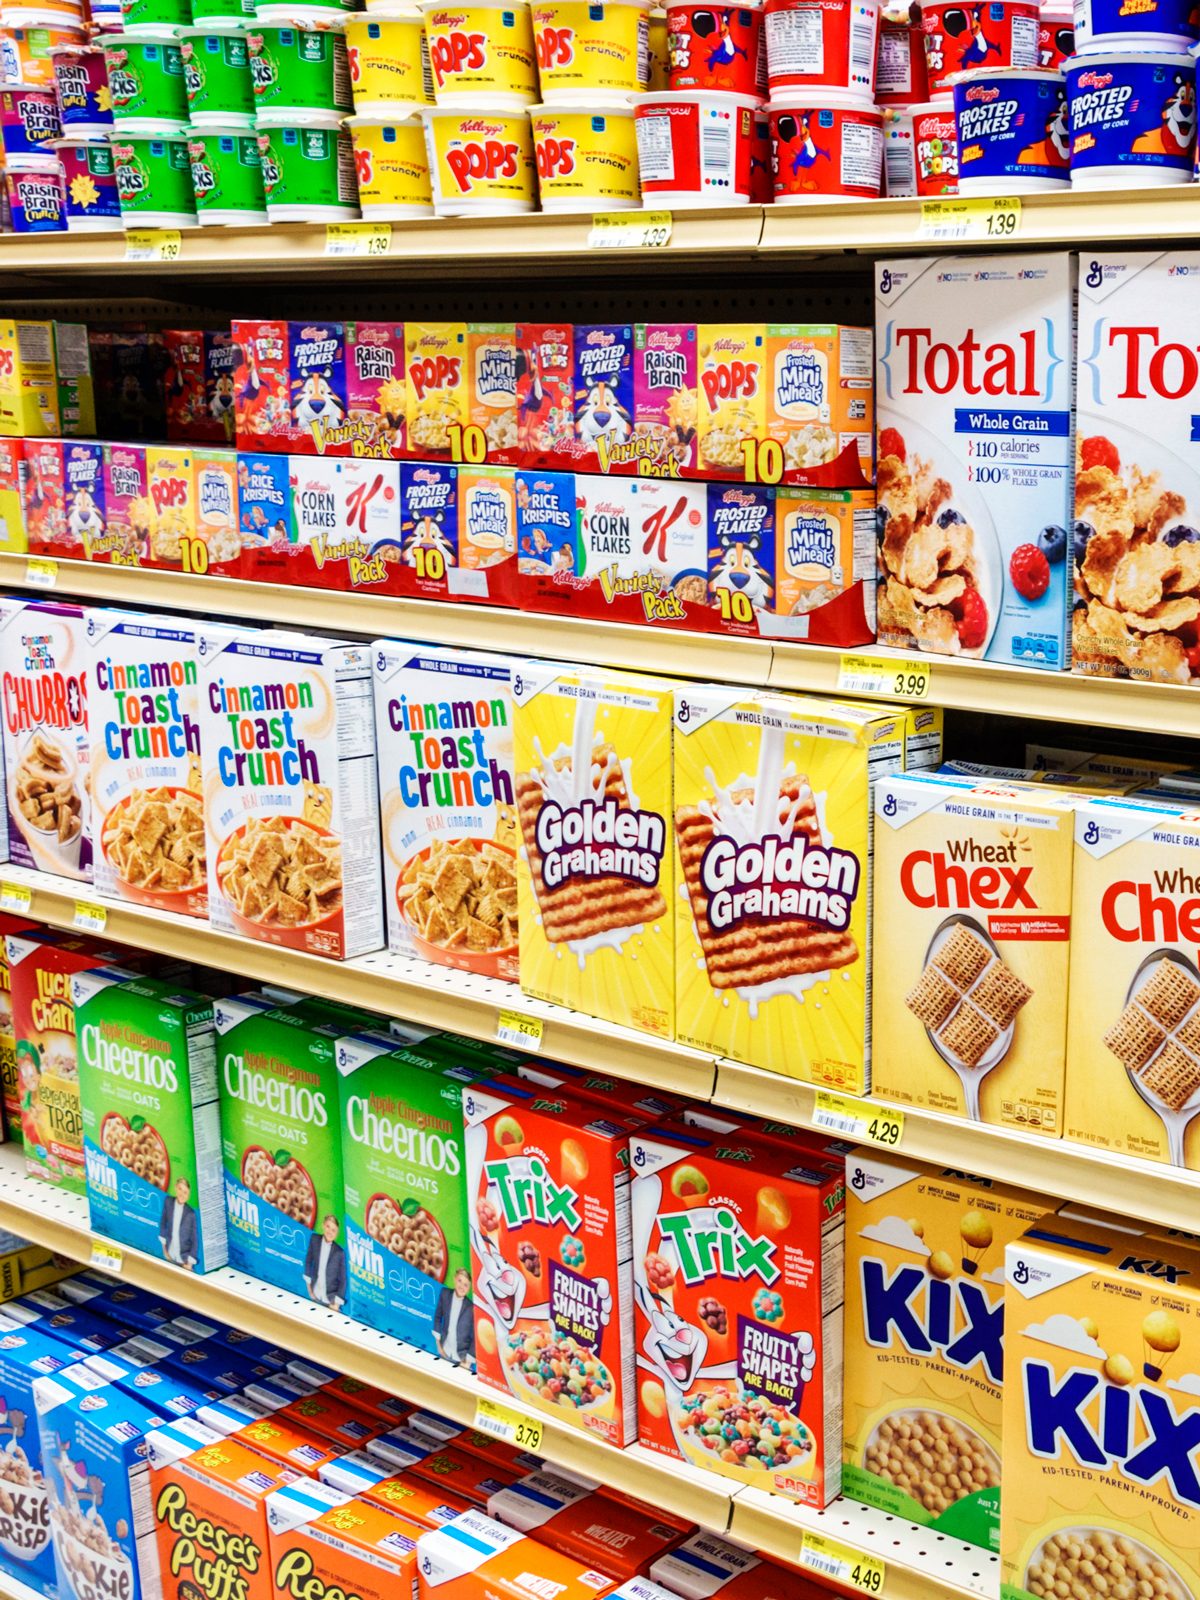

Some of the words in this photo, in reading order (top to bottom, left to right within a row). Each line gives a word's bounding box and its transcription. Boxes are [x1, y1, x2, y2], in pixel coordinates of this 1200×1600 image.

[448, 141, 519, 193] POPS
[986, 214, 1016, 235] 1.39
[579, 345, 624, 364] FROSTED
[582, 358, 621, 376] FLAKES
[644, 352, 685, 373] Raisin
[897, 328, 1041, 396] Total
[648, 366, 682, 388] Bran
[702, 361, 758, 413] POPS
[778, 383, 823, 405] Wheats
[781, 366, 823, 389] Mini
[596, 432, 664, 473] Variety
[740, 438, 784, 483] 10
[522, 508, 571, 525] KRISPIES
[531, 495, 559, 509] RICE
[590, 513, 629, 534] CORN
[642, 496, 688, 562] K
[591, 533, 631, 554] FLAKES
[350, 557, 387, 585] Pack
[415, 548, 445, 579] 10
[208, 679, 313, 714] Cinnamon
[894, 674, 925, 696] 3.99
[230, 711, 294, 749] Toast
[388, 695, 508, 733] Cinnamon
[218, 739, 317, 788] Crunch
[412, 728, 486, 770] Toast
[399, 757, 511, 808] Crunch
[537, 801, 664, 855] Golden
[1153, 832, 1181, 845] WHOLE
[543, 849, 657, 885] Grahams
[703, 836, 858, 894] Golden
[947, 838, 1017, 862] Wheat
[900, 850, 1039, 910] Chex
[710, 887, 850, 930] Grahams
[81, 1024, 178, 1092] Cheerios
[224, 1053, 328, 1127] Cheerios
[347, 1094, 460, 1175] Cheerios
[869, 1119, 899, 1144] 4.29
[406, 1172, 439, 1194] OATS
[483, 1156, 584, 1232] Trix
[657, 1206, 781, 1285] Trix
[744, 1326, 800, 1356] FRUITY
[742, 1351, 799, 1387] SHAPES
[744, 1373, 763, 1389] ARE
[765, 1381, 793, 1399] BACK!
[515, 1424, 539, 1447] 3.79
[157, 1482, 262, 1573] Reese's
[171, 1539, 248, 1600] Puffs
[851, 1570, 881, 1592] 4.49
